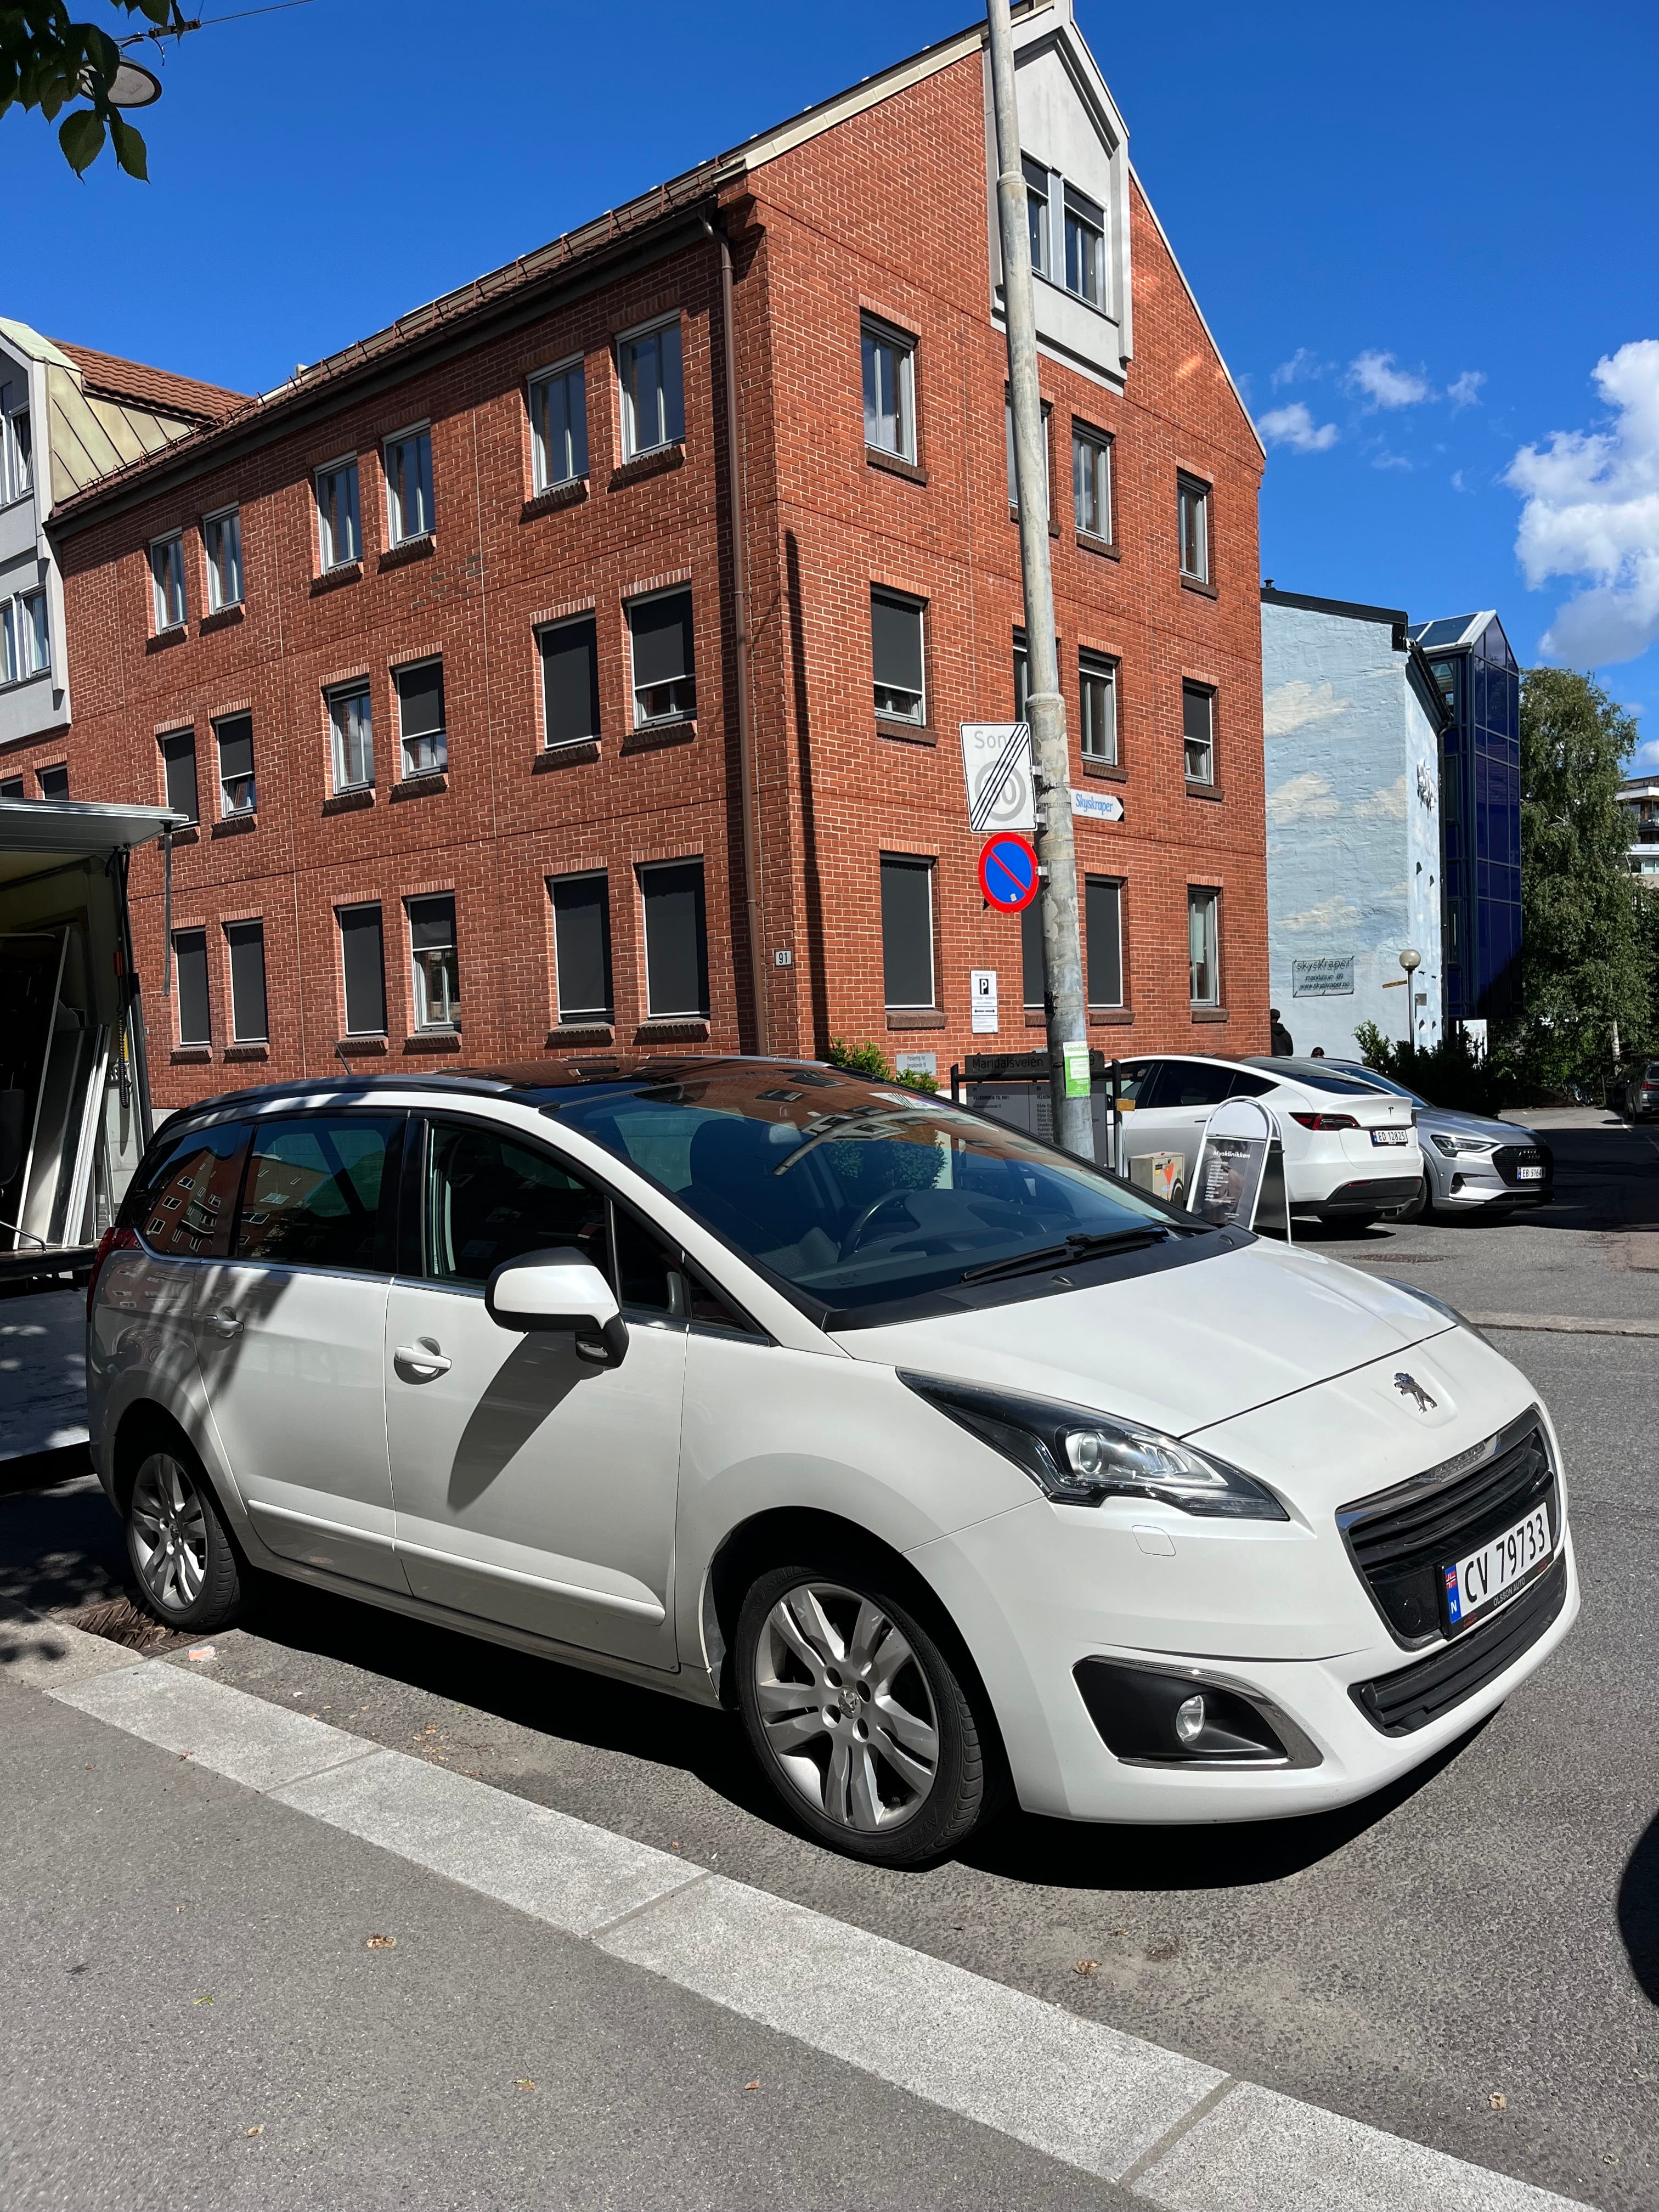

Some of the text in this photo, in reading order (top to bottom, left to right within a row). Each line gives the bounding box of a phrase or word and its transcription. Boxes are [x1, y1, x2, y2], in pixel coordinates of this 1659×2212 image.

[1076, 793, 1113, 815] Skyskraper
[779, 952, 787, 964] 91
[972, 1057, 1043, 1068] Maridalsveien
[1378, 1132, 1405, 1141] ED 12825
[1212, 1150, 1250, 1159] Myoklinikken
[1522, 1169, 1529, 1178] EB
[1465, 1513, 1545, 1603] CV 79733
[1493, 1577, 1525, 1606] OLSSON AUTO
[1451, 1599, 1457, 1614] N
